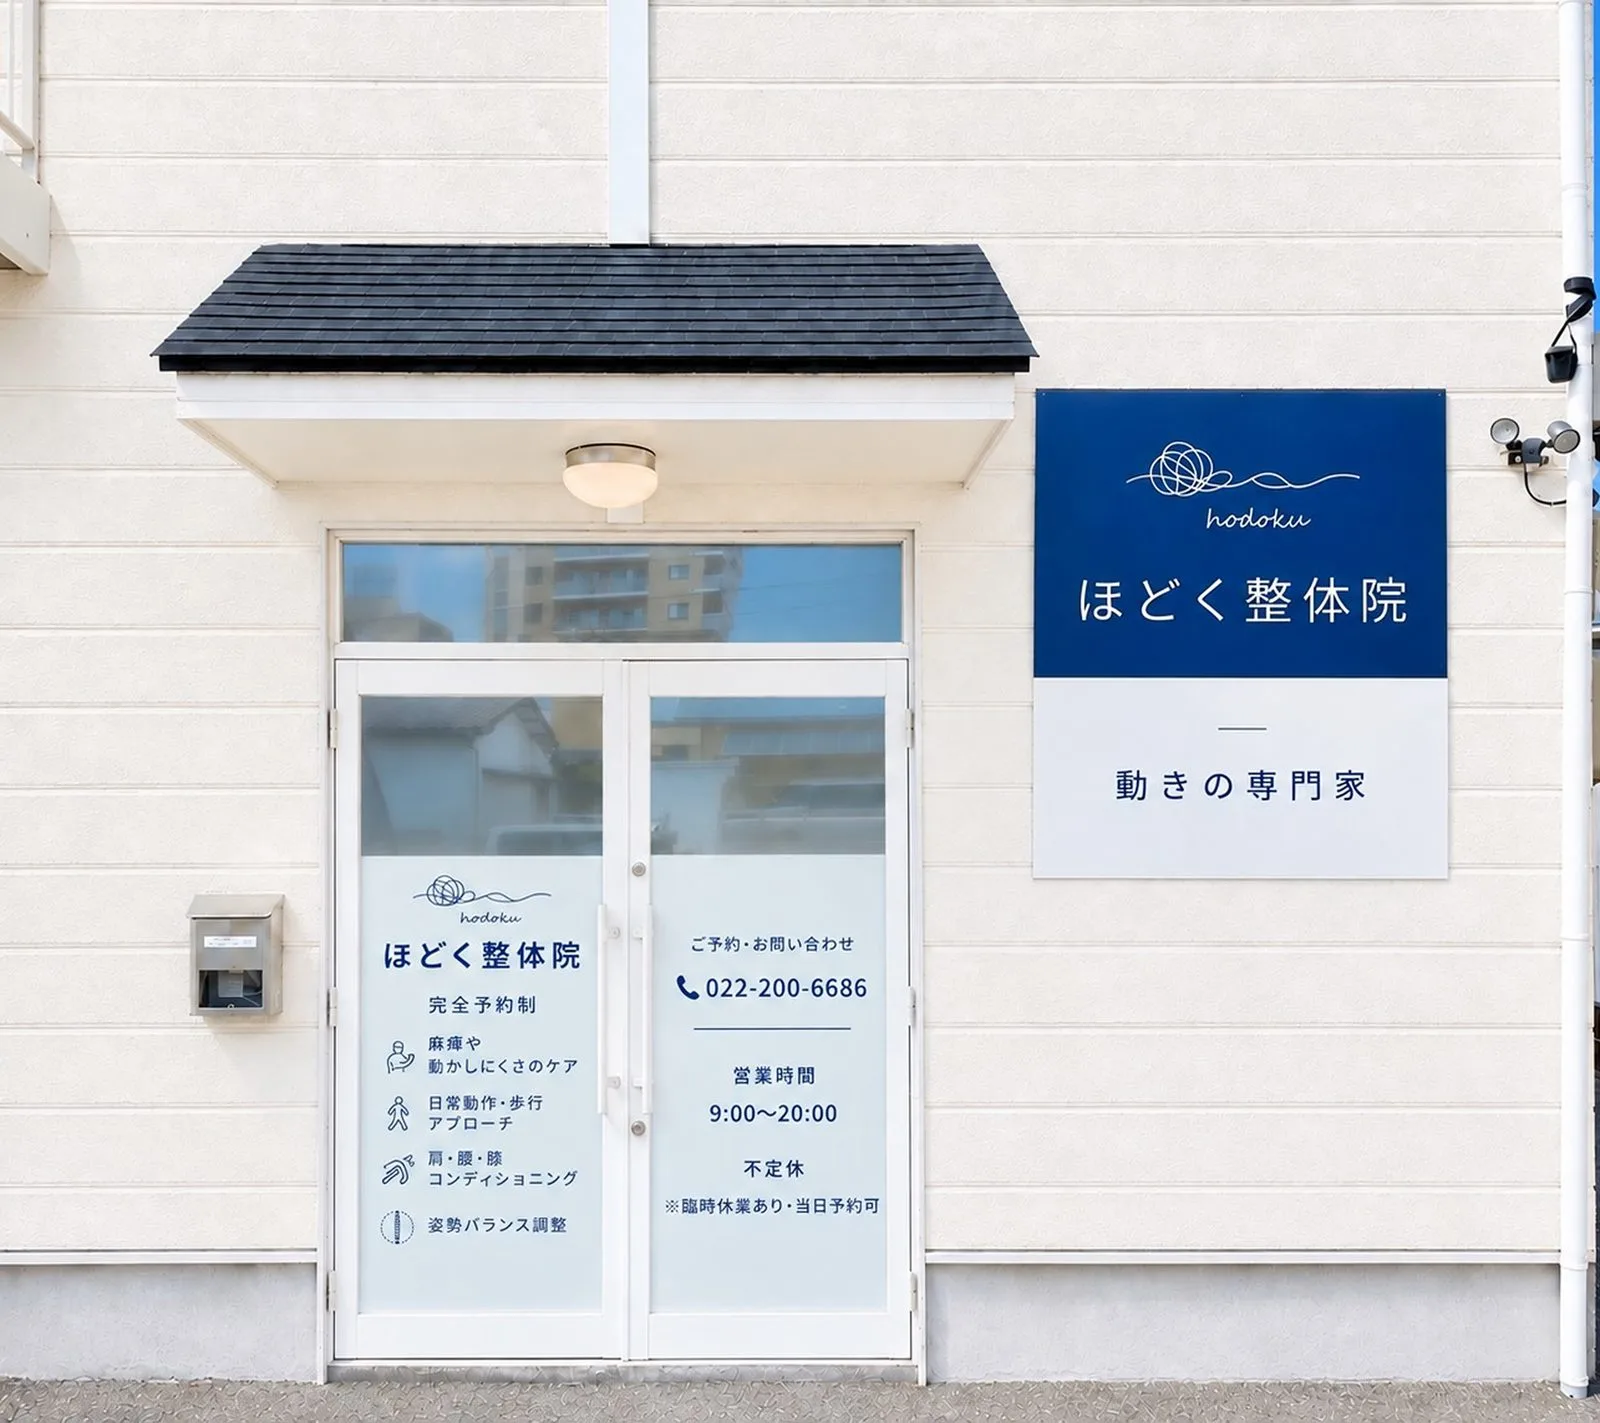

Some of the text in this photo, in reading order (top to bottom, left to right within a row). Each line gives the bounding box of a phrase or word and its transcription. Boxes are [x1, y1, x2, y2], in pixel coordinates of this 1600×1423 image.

[1206, 506, 1312, 529] hodoku
[1079, 576, 1407, 624] ほどく整体院
[1115, 769, 1366, 802] 動きの専門家
[459, 911, 522, 924] hodoku
[691, 935, 855, 953] ご予約・お問い合わせ
[384, 940, 581, 970] ほどく整体院
[705, 977, 868, 998] 022-200-6686
[428, 995, 536, 1015] 完全予約制
[428, 1058, 578, 1075] 動かしにくさのケア
[733, 1065, 815, 1086] 営業時間
[429, 1094, 543, 1112] 日常動作・歩行
[428, 1115, 513, 1131] アプローチ
[743, 1158, 805, 1179] 不定休
[429, 1170, 578, 1188] コンディショニング
[427, 1216, 567, 1234] 姿勢バランス調整
